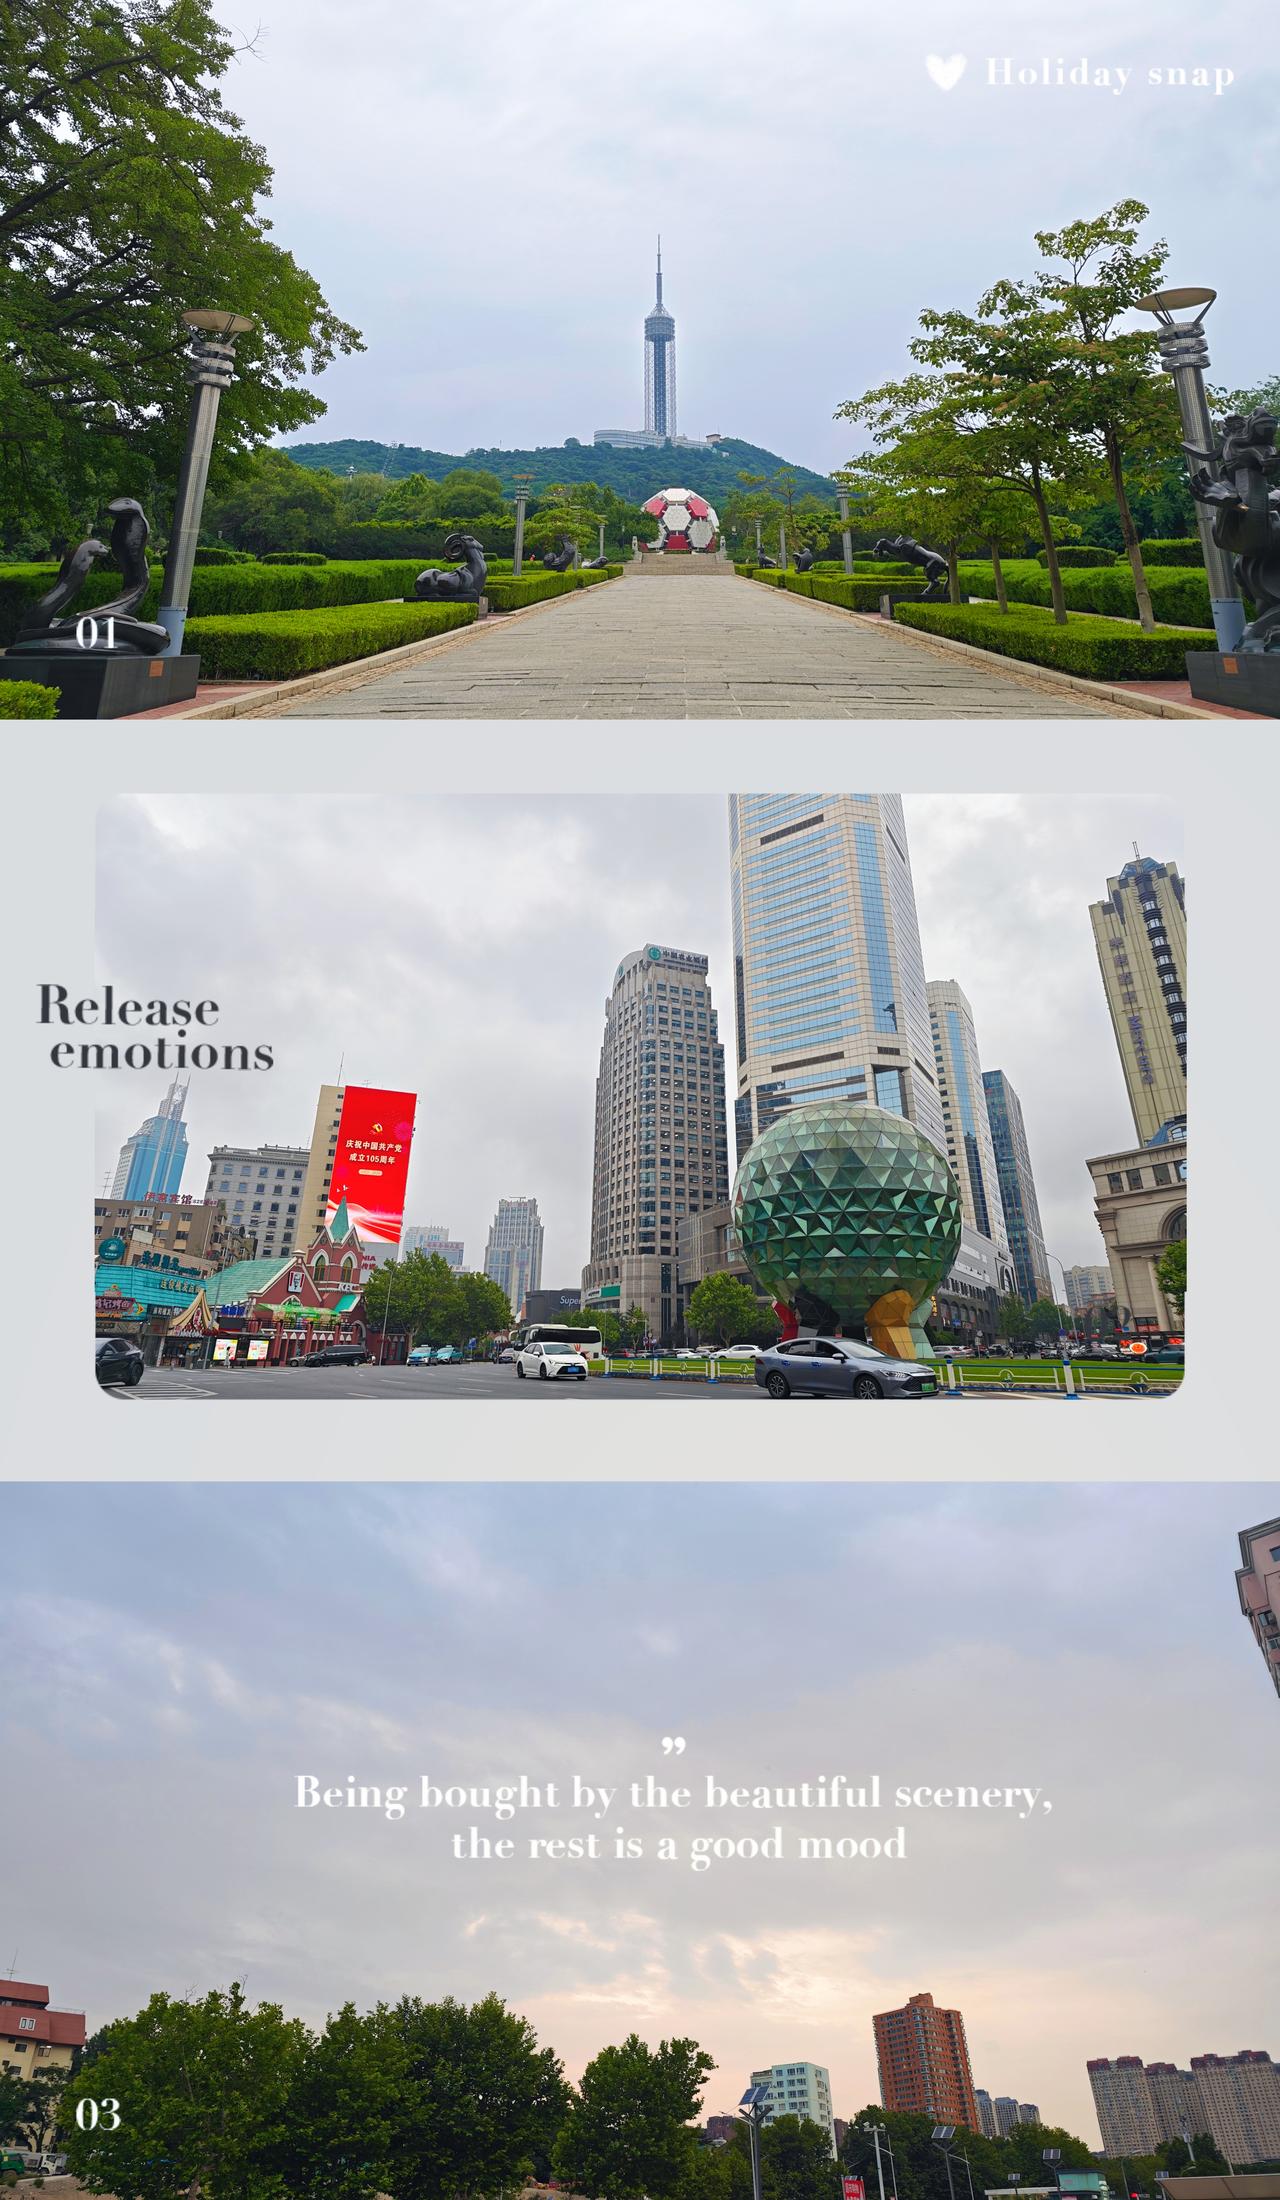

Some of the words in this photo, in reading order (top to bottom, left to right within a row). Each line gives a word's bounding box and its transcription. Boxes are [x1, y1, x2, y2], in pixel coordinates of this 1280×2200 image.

[345, 1139, 403, 1153] 庆祝中国共产党
[349, 1152, 396, 1165] 成立105周年
